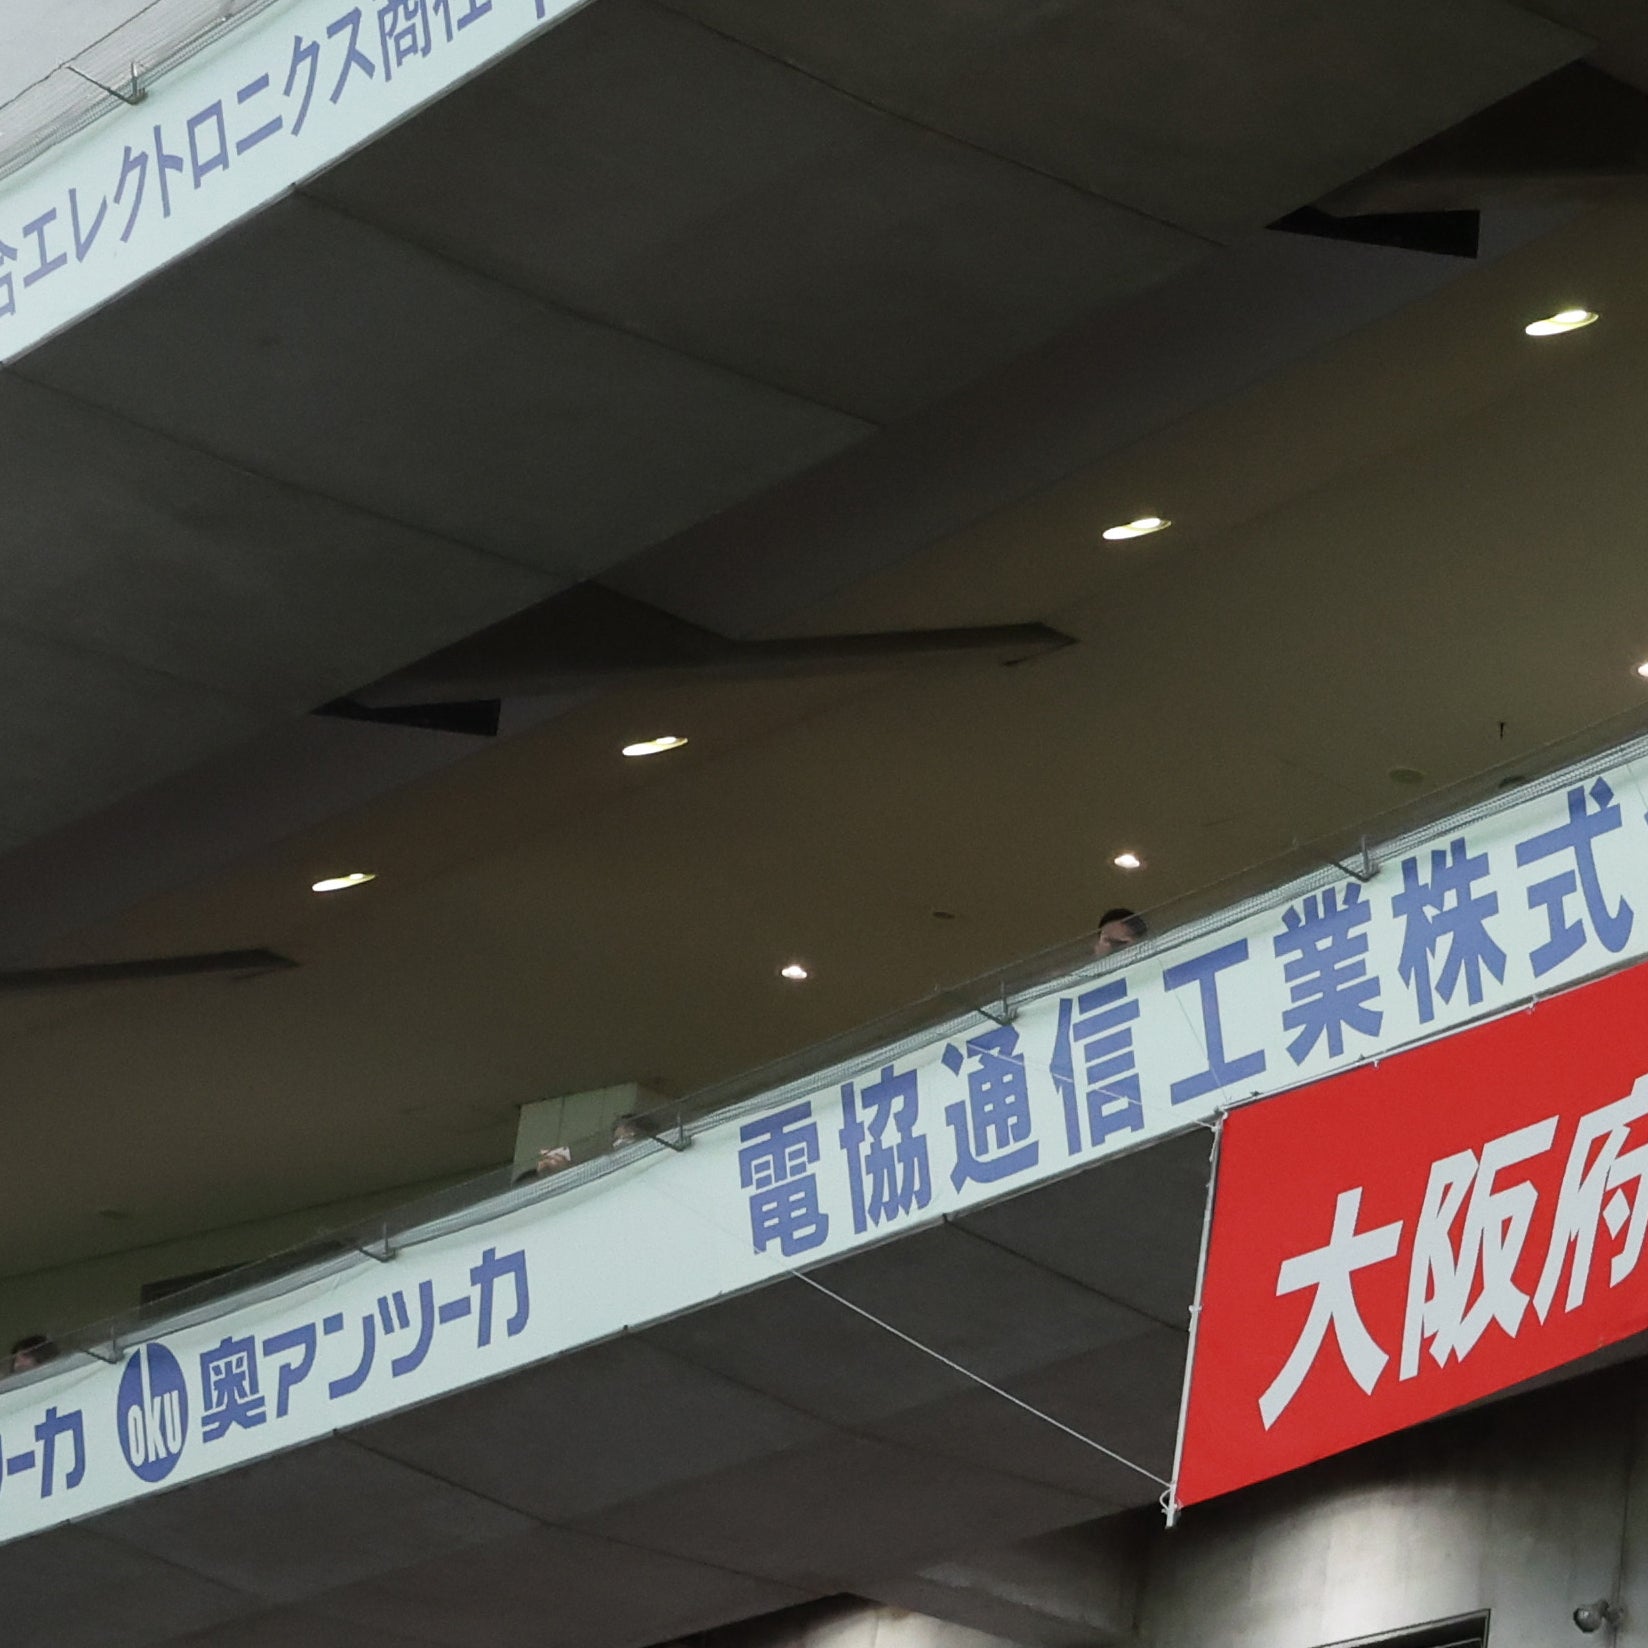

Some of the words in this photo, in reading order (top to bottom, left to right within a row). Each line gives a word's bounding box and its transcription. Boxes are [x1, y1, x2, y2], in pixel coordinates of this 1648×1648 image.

[200, 1247, 530, 1443] 奥アンツーカ
[0, 1406, 86, 1498] ーカ
